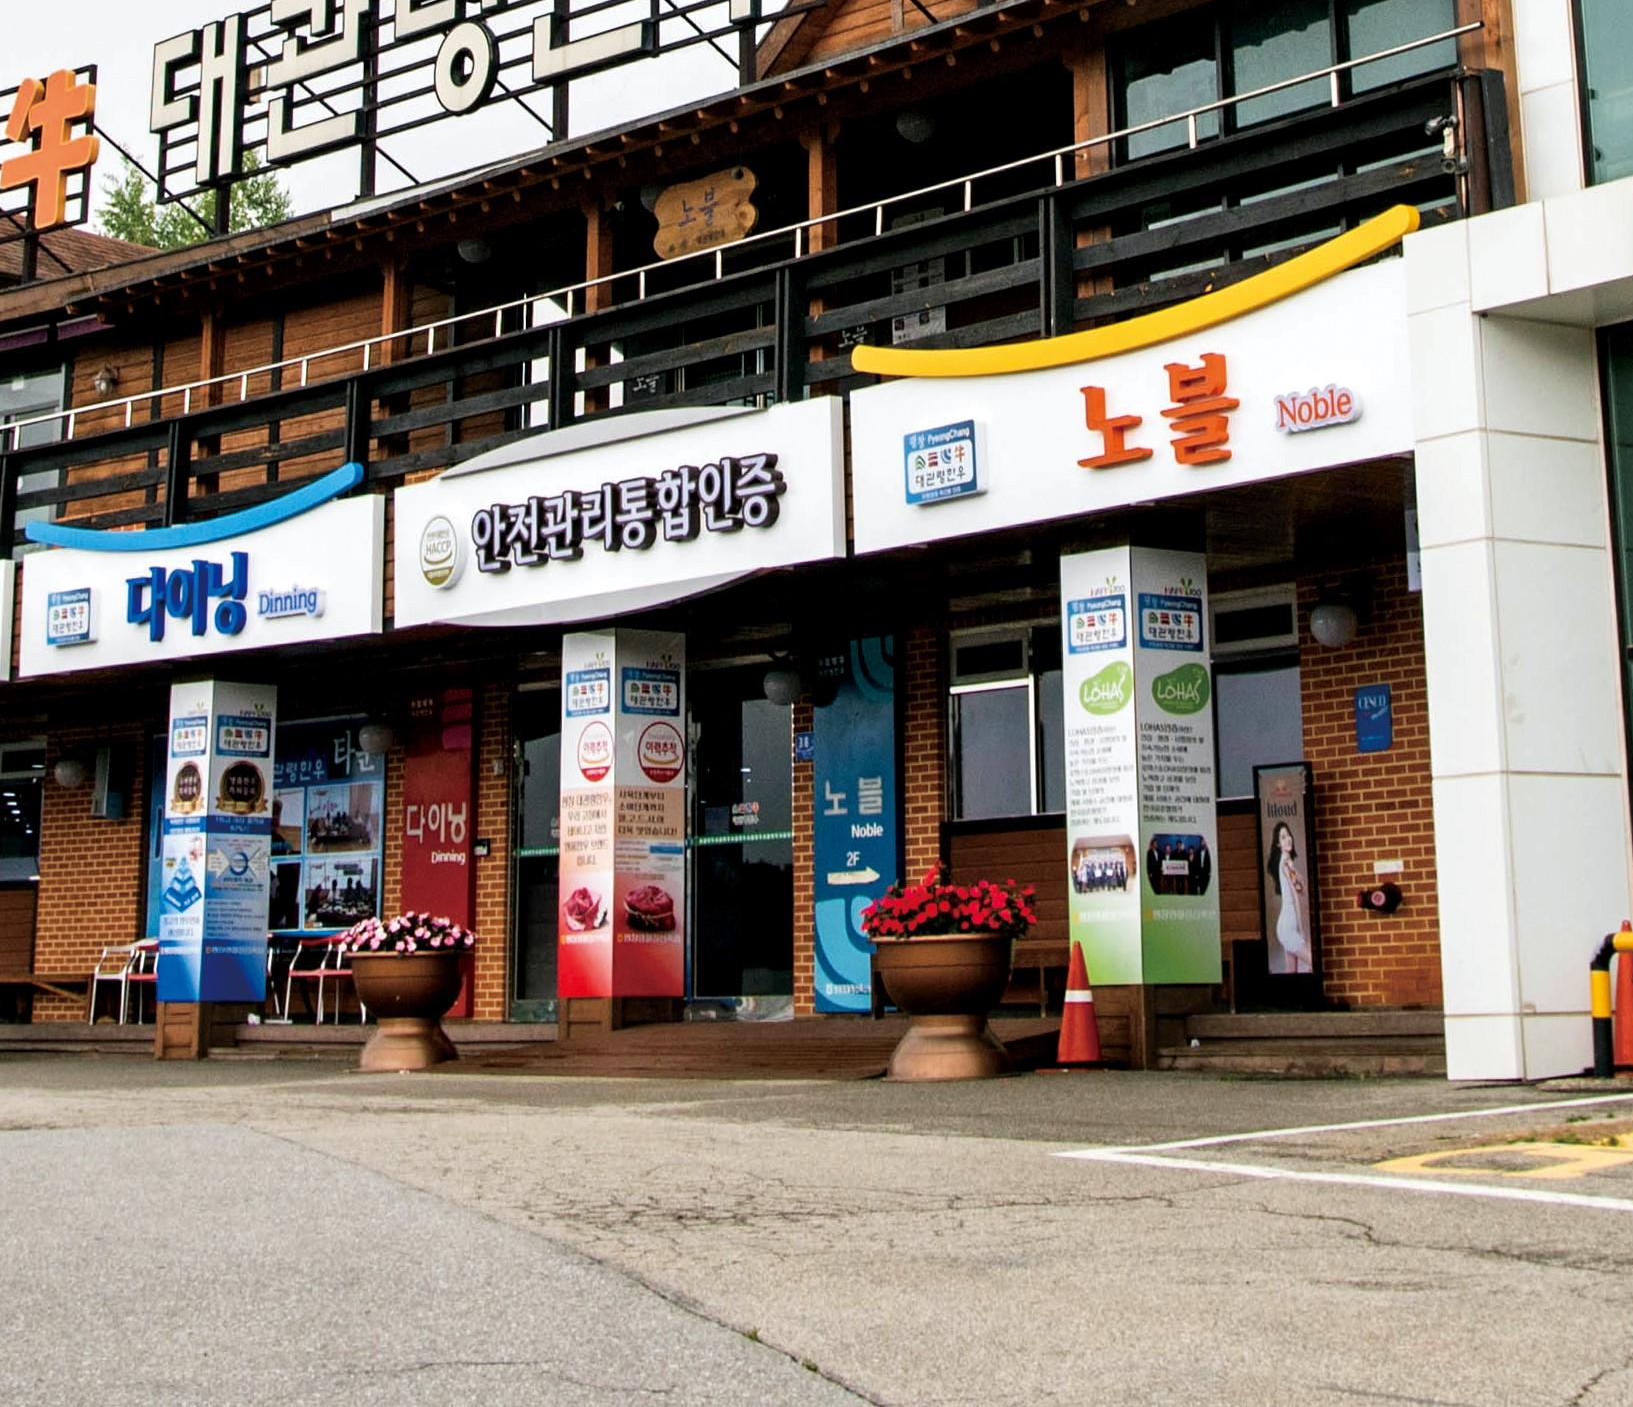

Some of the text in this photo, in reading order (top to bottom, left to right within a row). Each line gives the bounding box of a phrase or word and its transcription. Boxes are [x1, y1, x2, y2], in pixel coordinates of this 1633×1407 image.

[1077, 353, 1352, 469] 노블 Noble
[472, 453, 778, 573] 안전관리통합인증
[425, 540, 451, 555] HACCP
[126, 551, 318, 642] 다이닝 Dinning
[1157, 678, 1202, 703] LOHAS
[824, 776, 883, 816] 노블
[406, 801, 467, 843] 다이닝
[851, 822, 884, 838] Noble
[431, 851, 465, 865] Dinning
[846, 851, 861, 867] 2F
